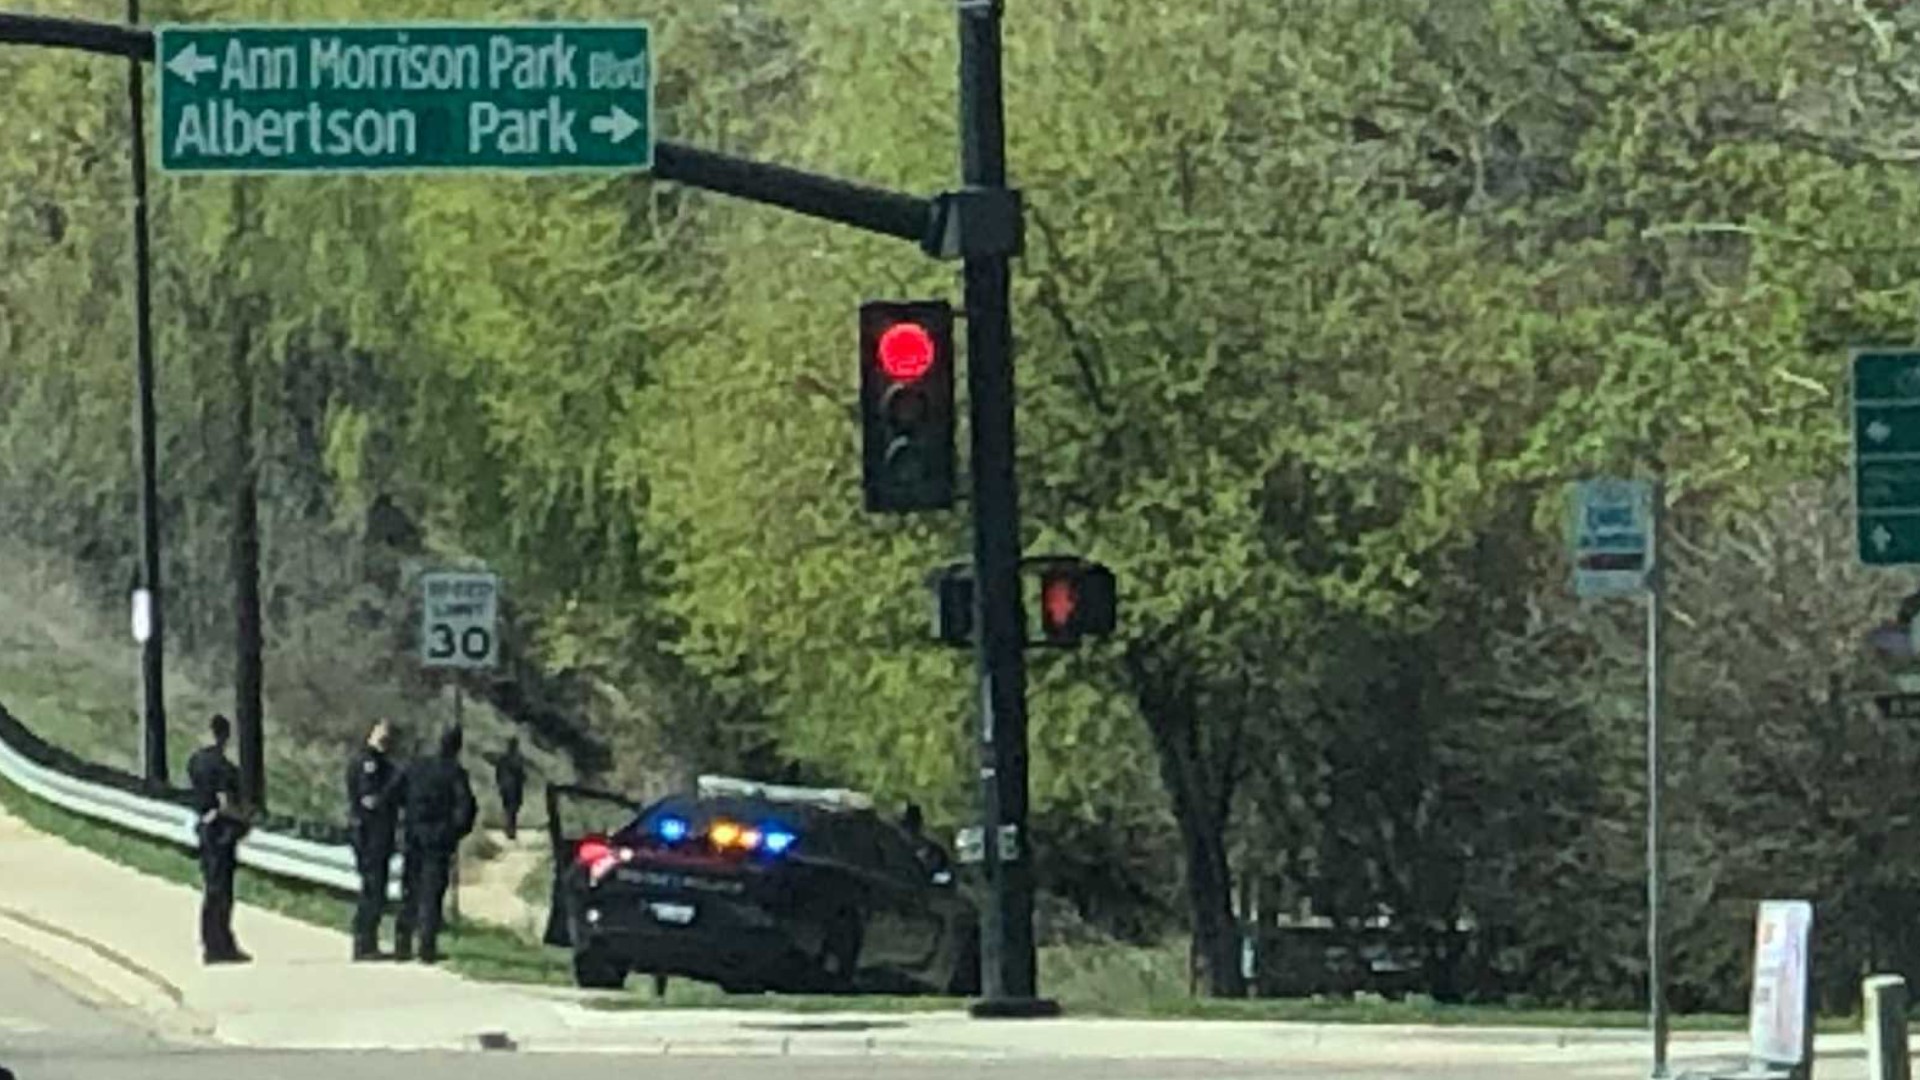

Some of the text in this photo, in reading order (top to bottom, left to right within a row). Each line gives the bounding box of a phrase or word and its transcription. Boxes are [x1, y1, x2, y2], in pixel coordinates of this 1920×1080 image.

[220, 37, 298, 90] Ann
[309, 34, 480, 90] Morrison
[488, 34, 578, 90] Park
[172, 97, 578, 157] Albertson Park
[428, 622, 490, 661] 30
